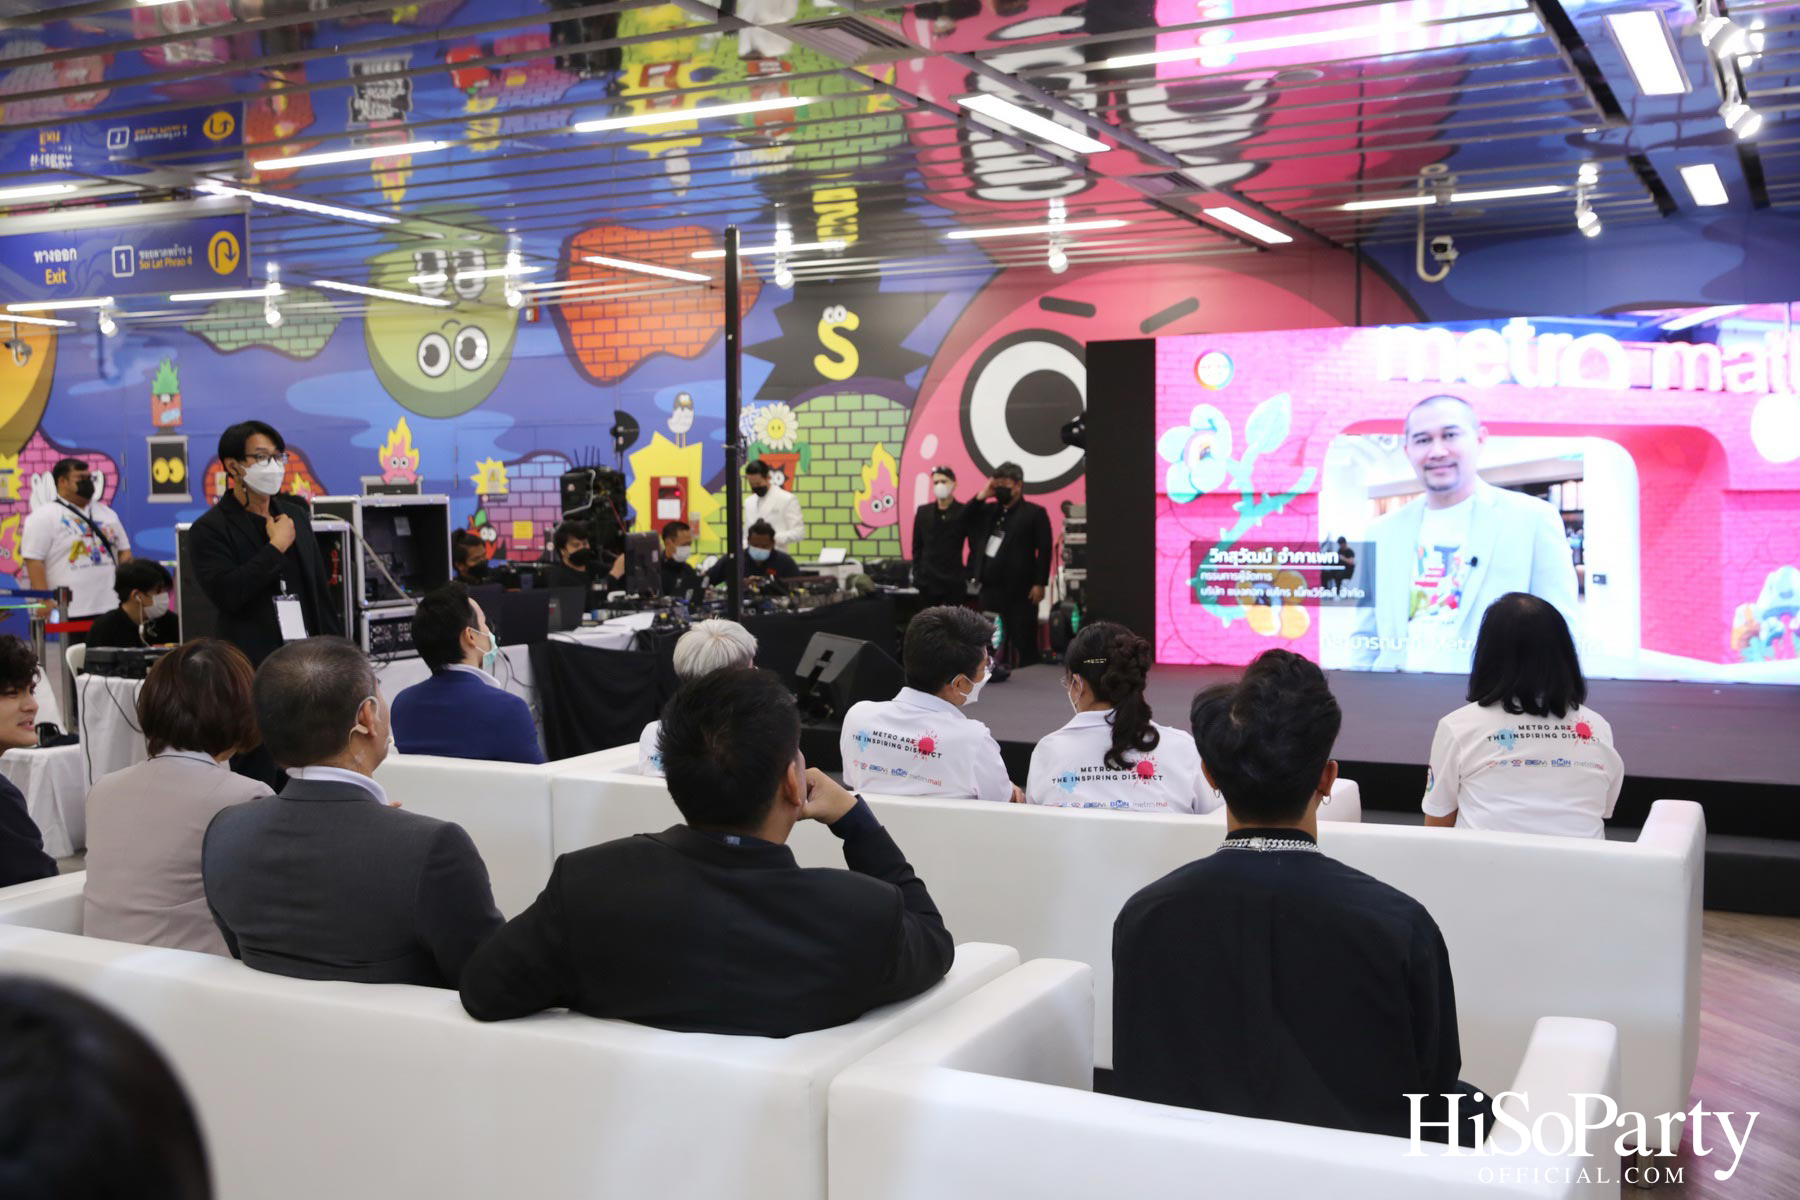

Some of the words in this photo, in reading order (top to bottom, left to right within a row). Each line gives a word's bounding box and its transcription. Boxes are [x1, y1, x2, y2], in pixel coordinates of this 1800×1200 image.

[33, 247, 77, 264] ทางออก
[119, 253, 126, 271] 1
[139, 259, 150, 270] Soi
[152, 258, 164, 269] Lat
[165, 257, 186, 268] Phrao
[187, 256, 192, 266] 4
[45, 268, 67, 285] Exit
[1377, 316, 1632, 388] metro
[872, 730, 898, 741] METRO
[1487, 734, 1505, 742] THE
[1509, 732, 1558, 740] INSPIRING
[852, 734, 862, 742] THE
[864, 736, 902, 750] INSPIRING
[904, 744, 943, 759] DISTRICT
[1071, 774, 1118, 782] INSPIRING
[1121, 773, 1163, 782] DISTRICT
